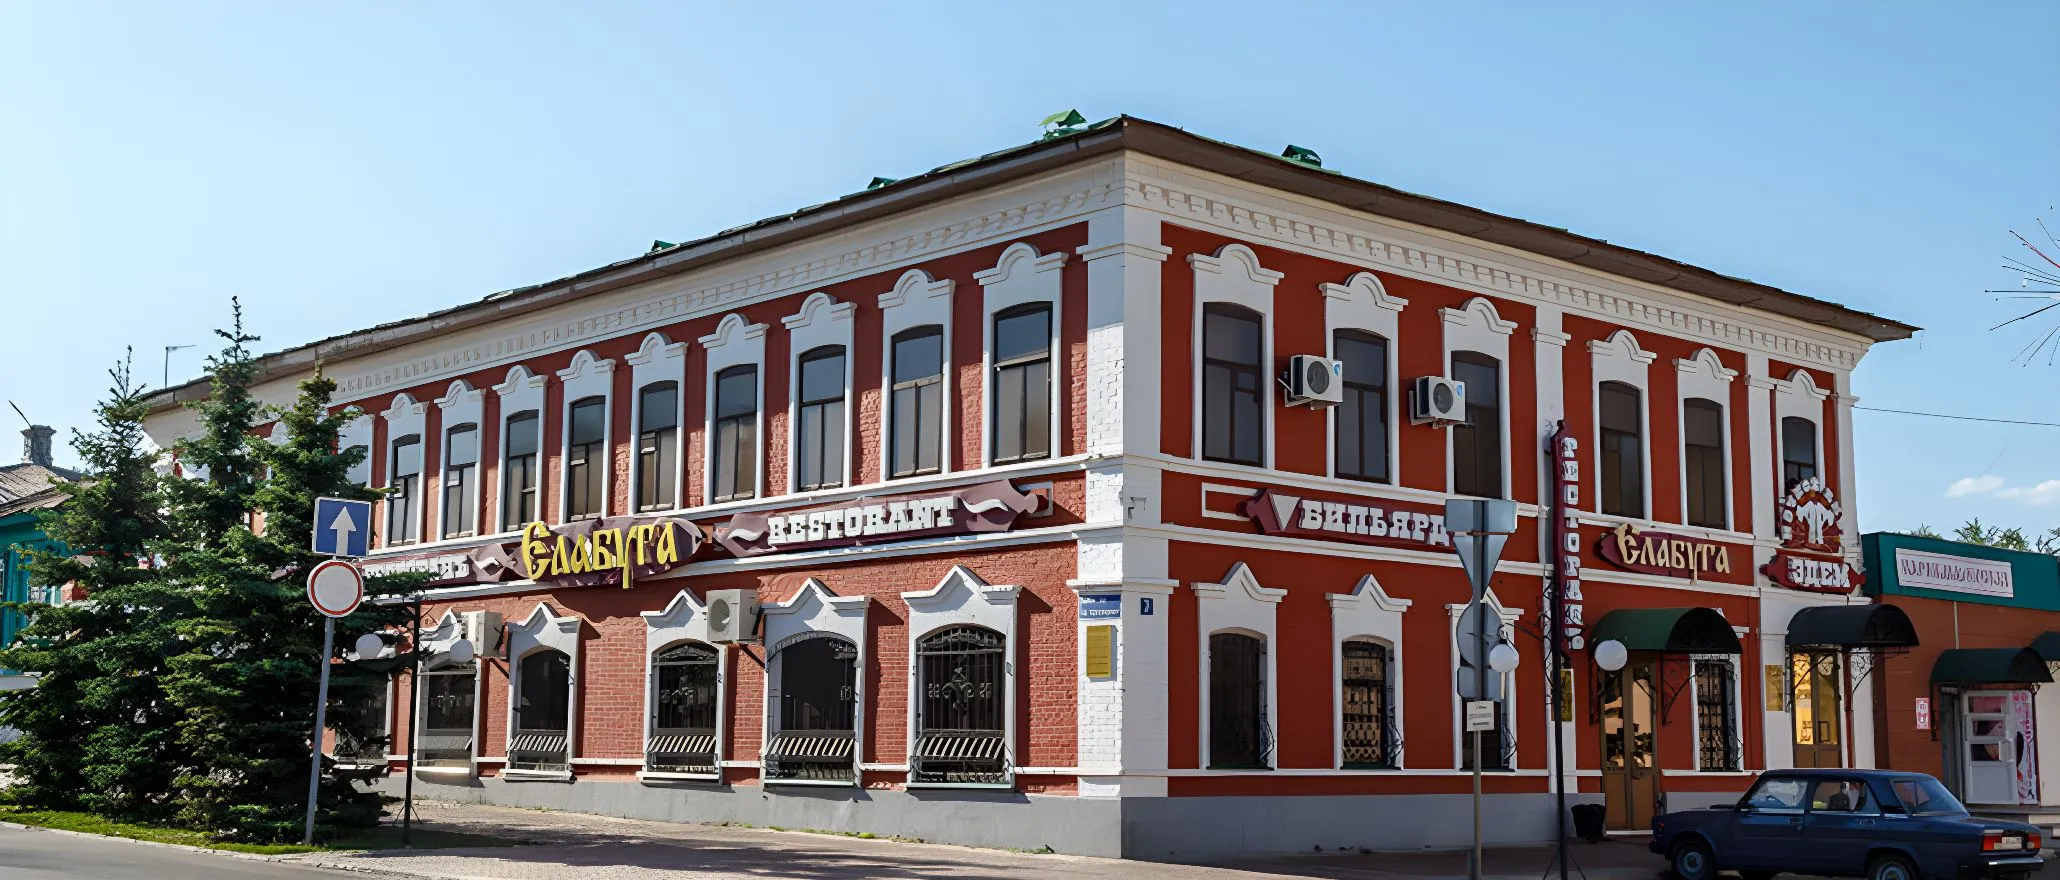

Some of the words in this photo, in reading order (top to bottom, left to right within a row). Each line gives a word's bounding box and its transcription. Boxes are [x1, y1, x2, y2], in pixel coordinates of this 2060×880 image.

[768, 496, 954, 545] RESTORANT
[1299, 499, 1450, 547] БИЛЬЯРД
[1143, 599, 1150, 613] 7
